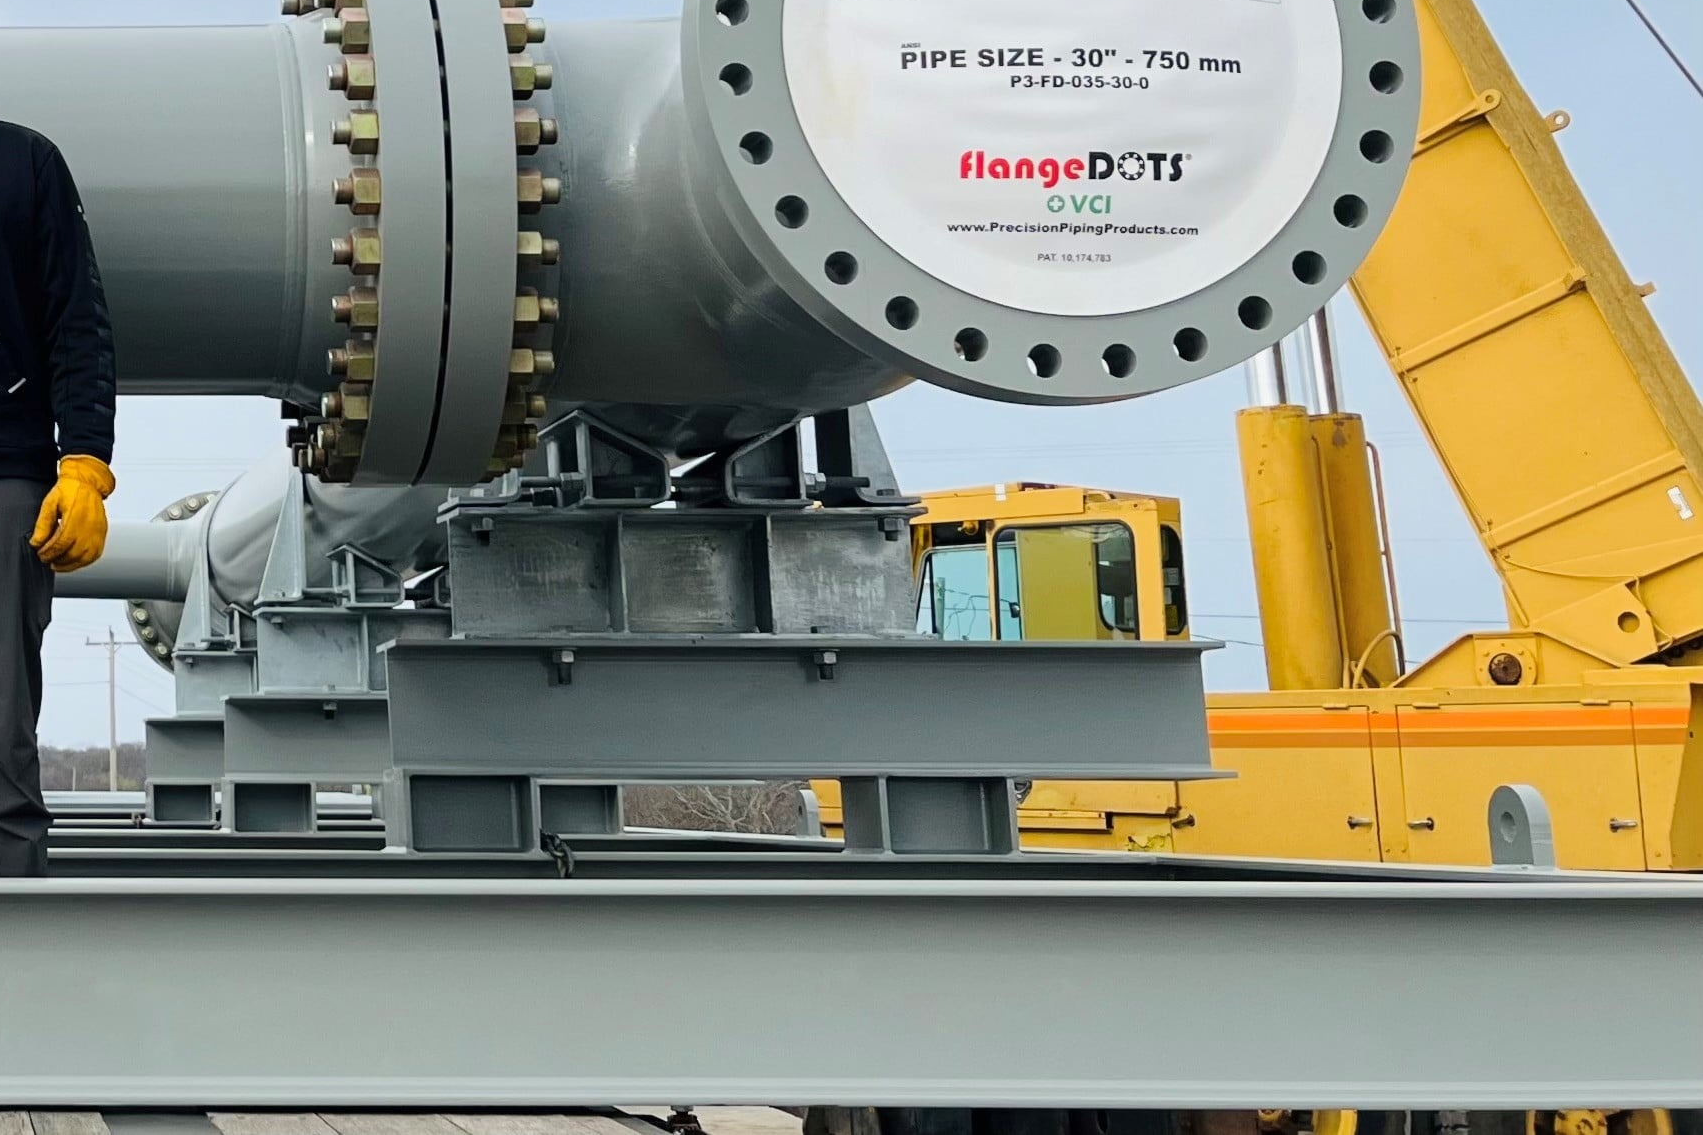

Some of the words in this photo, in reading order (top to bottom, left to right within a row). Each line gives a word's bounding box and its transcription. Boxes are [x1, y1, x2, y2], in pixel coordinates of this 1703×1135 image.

[901, 49, 968, 69] PIPE
[977, 48, 1044, 68] SIZE
[1071, 48, 1117, 68] 30"
[1142, 50, 1190, 70] 750
[1199, 57, 1242, 73] mm
[1010, 75, 1149, 90] P3-FD-035-30-0
[1069, 195, 1112, 214] VCI
[947, 222, 1199, 236] www.PrecisionPipingProducts.com
[1061, 254, 1112, 263] 10,174,783
